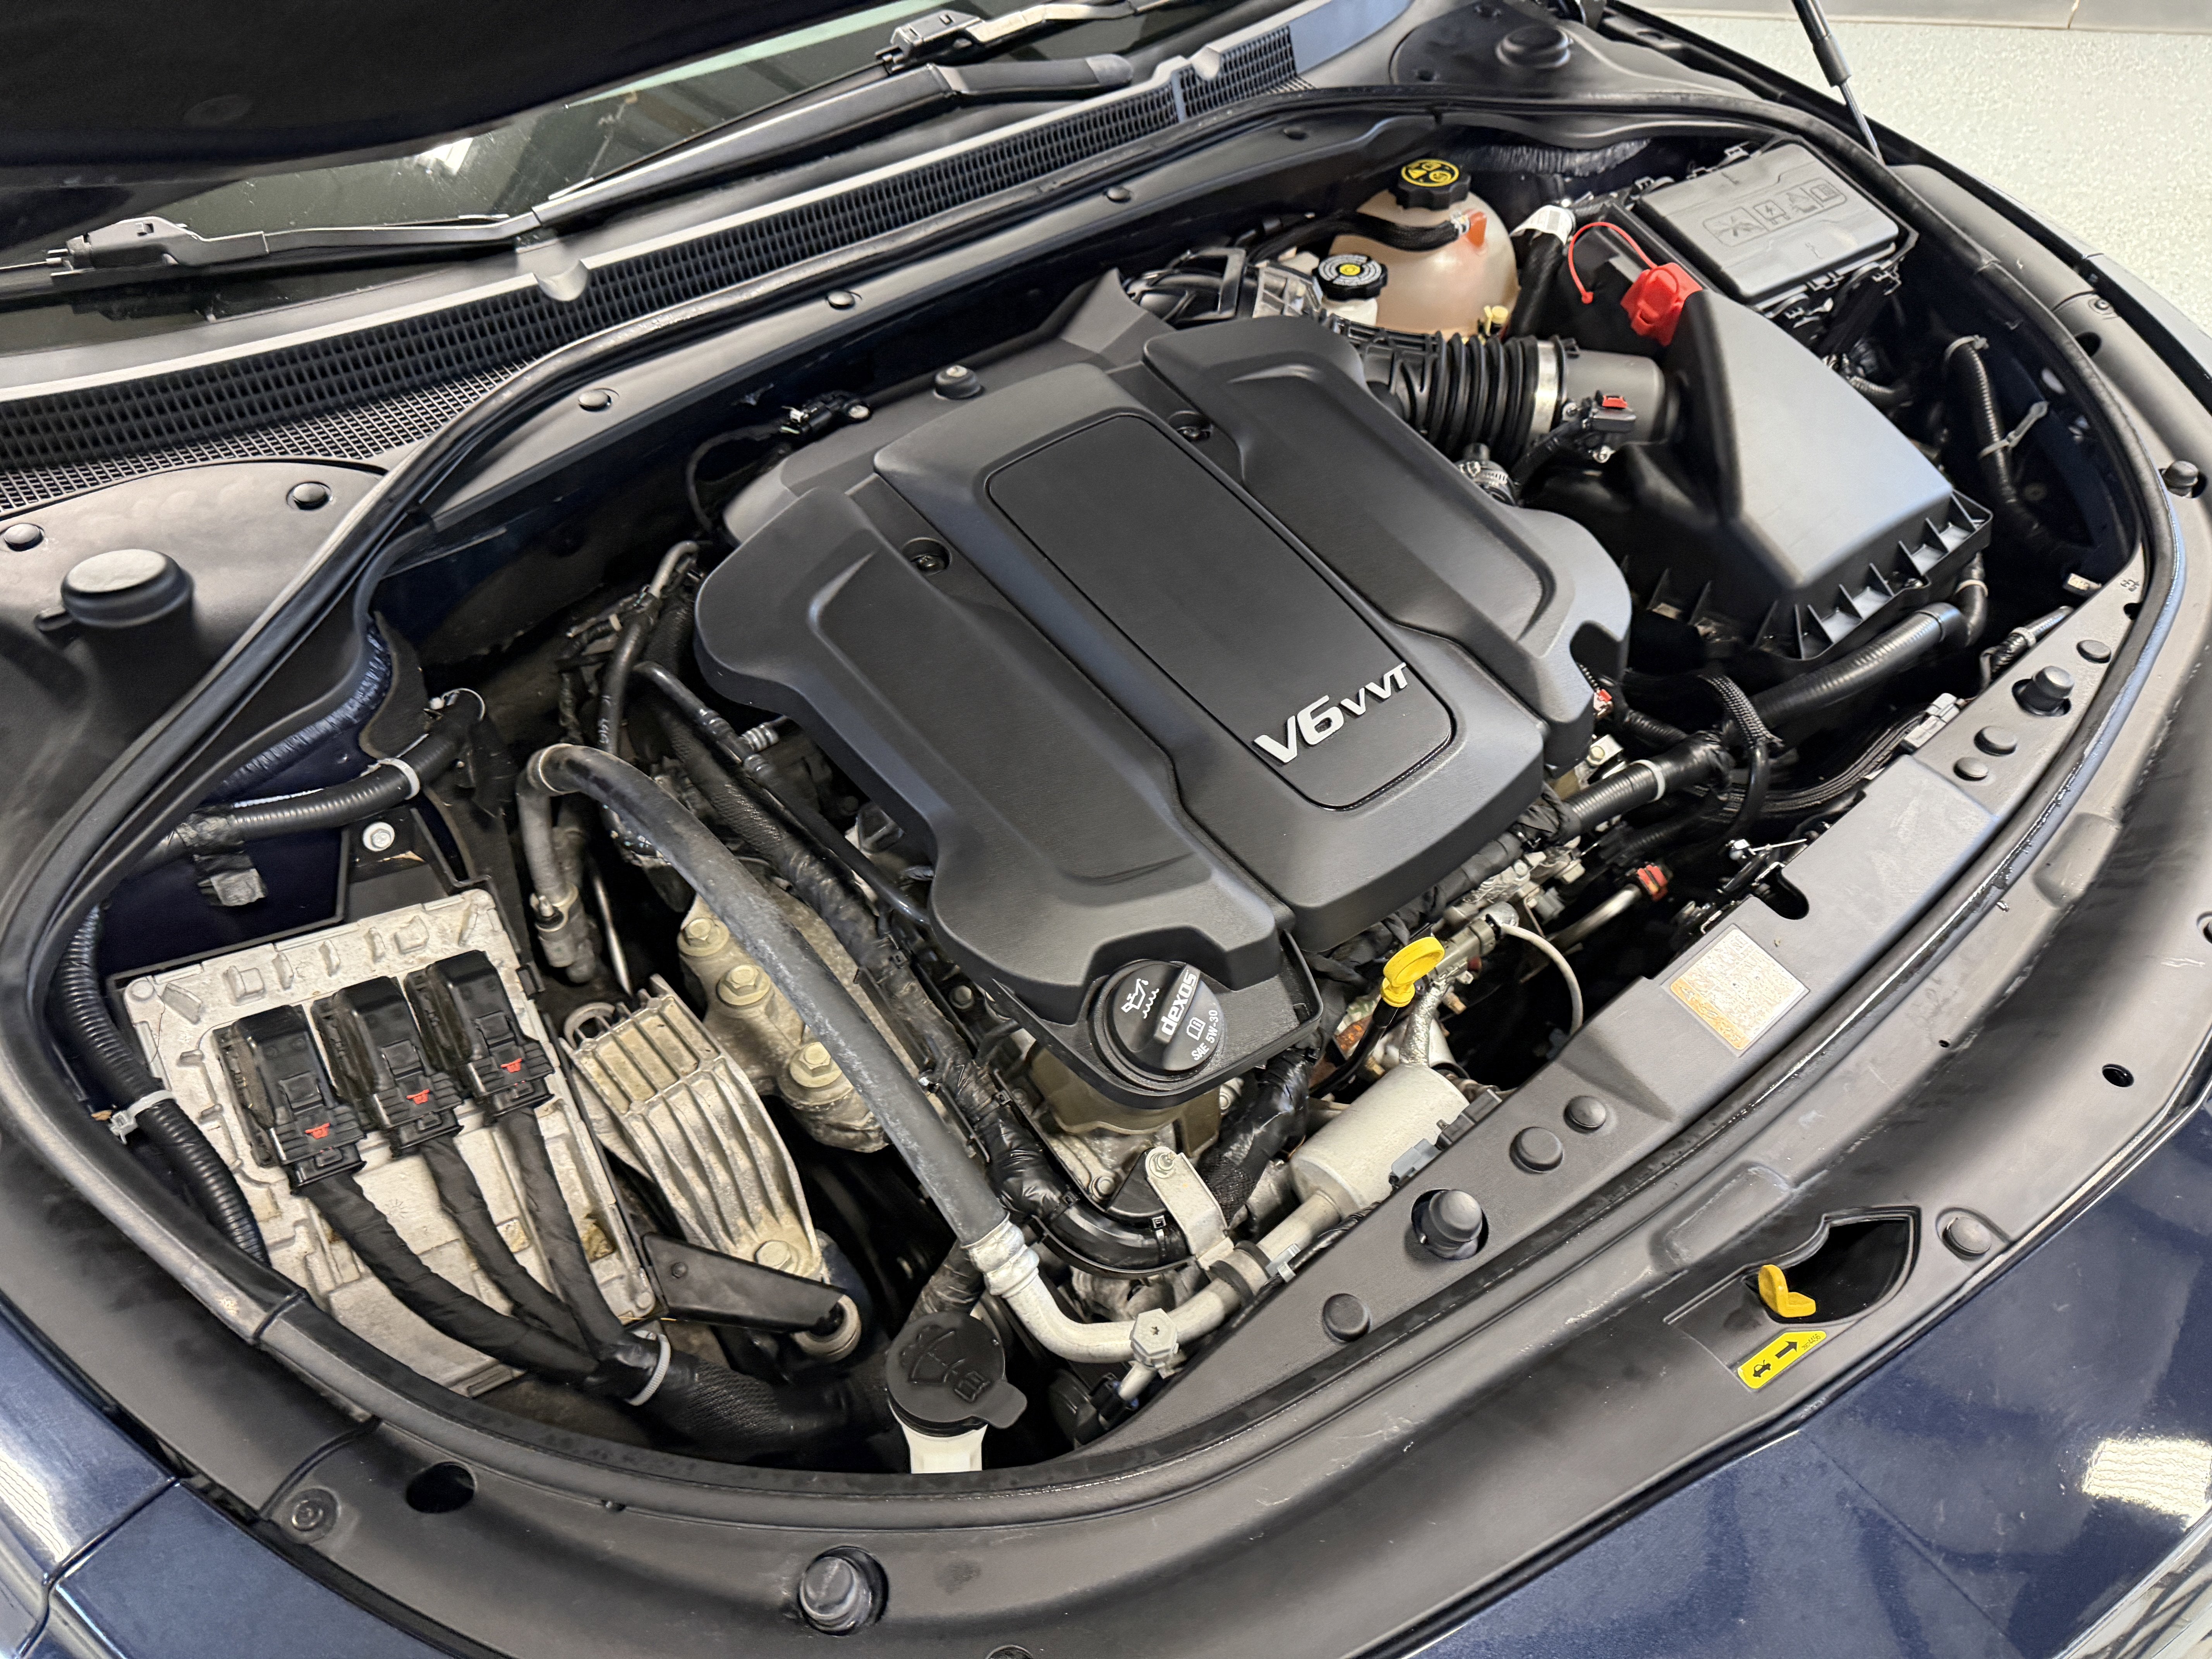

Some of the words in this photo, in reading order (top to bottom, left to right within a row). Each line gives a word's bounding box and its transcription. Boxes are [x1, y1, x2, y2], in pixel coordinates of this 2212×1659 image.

[1161, 969, 1197, 1036] dexos
[1191, 1042, 1209, 1061] SAE
[1205, 1010, 1218, 1044] 5W-30
